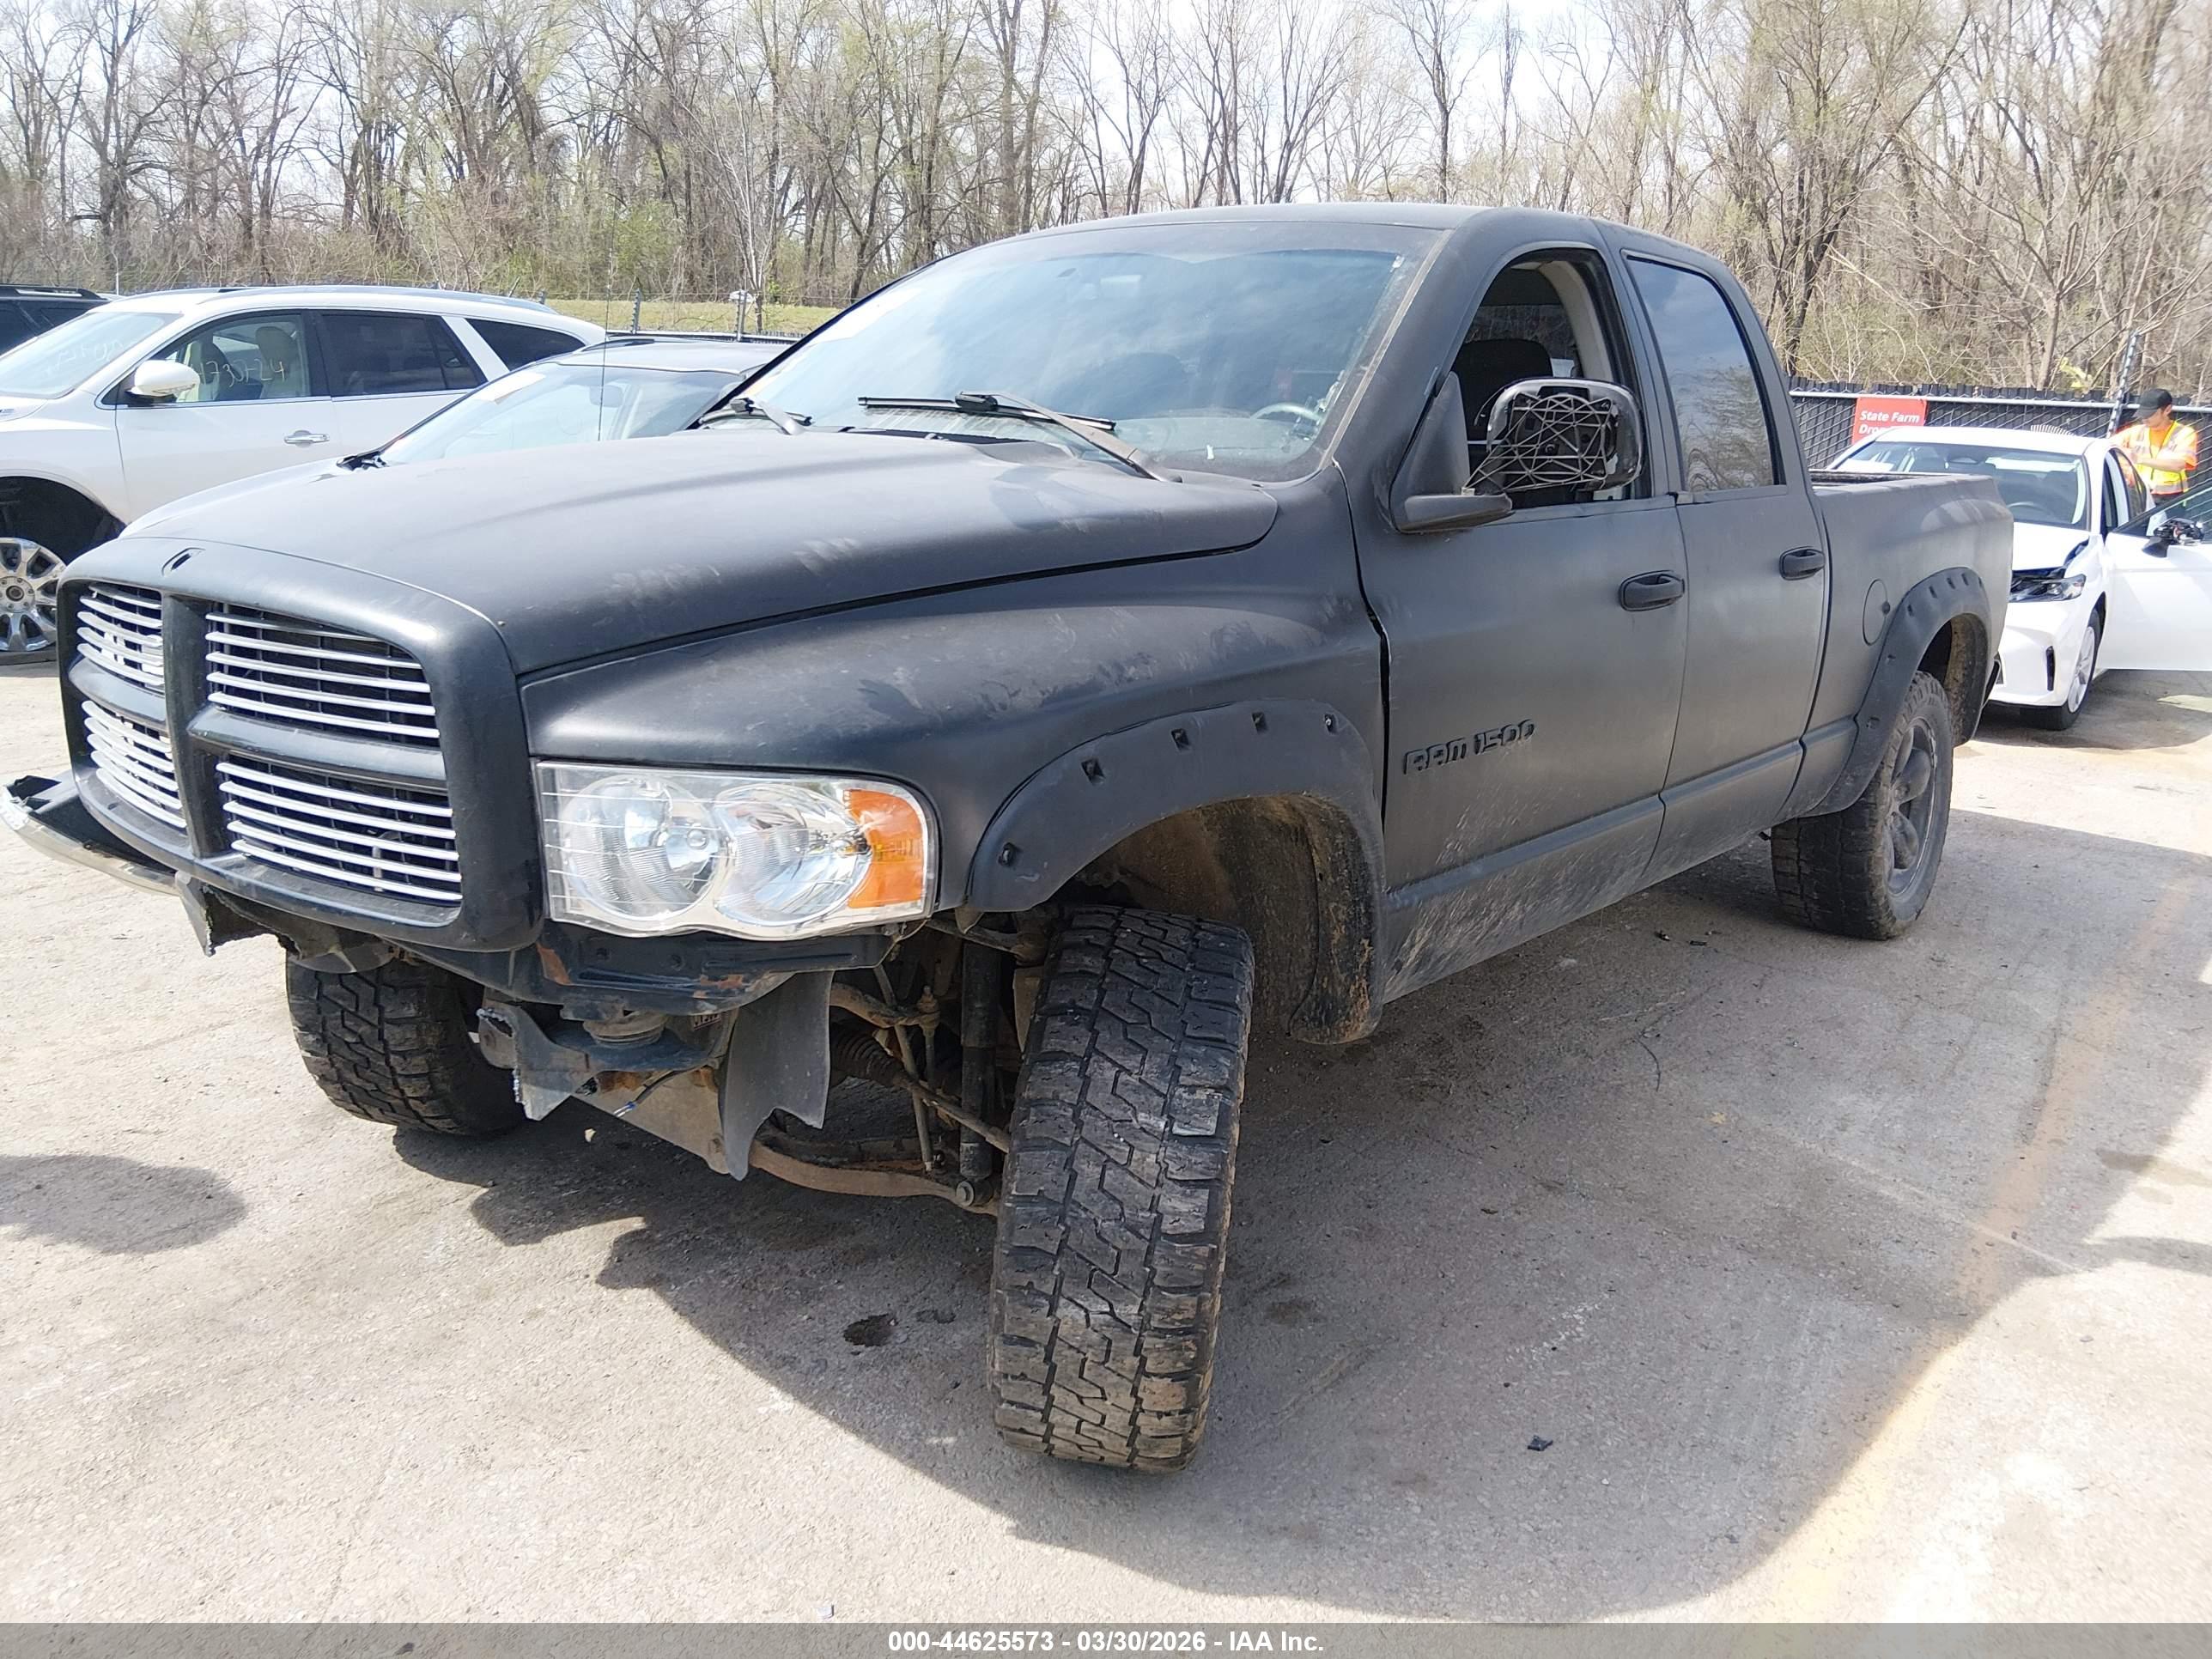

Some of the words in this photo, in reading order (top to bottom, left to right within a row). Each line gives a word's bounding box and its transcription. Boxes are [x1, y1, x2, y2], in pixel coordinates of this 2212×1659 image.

[1859, 410, 1889, 422] State
[1891, 412, 1920, 423] Farm
[1473, 719, 1535, 756] 1500
